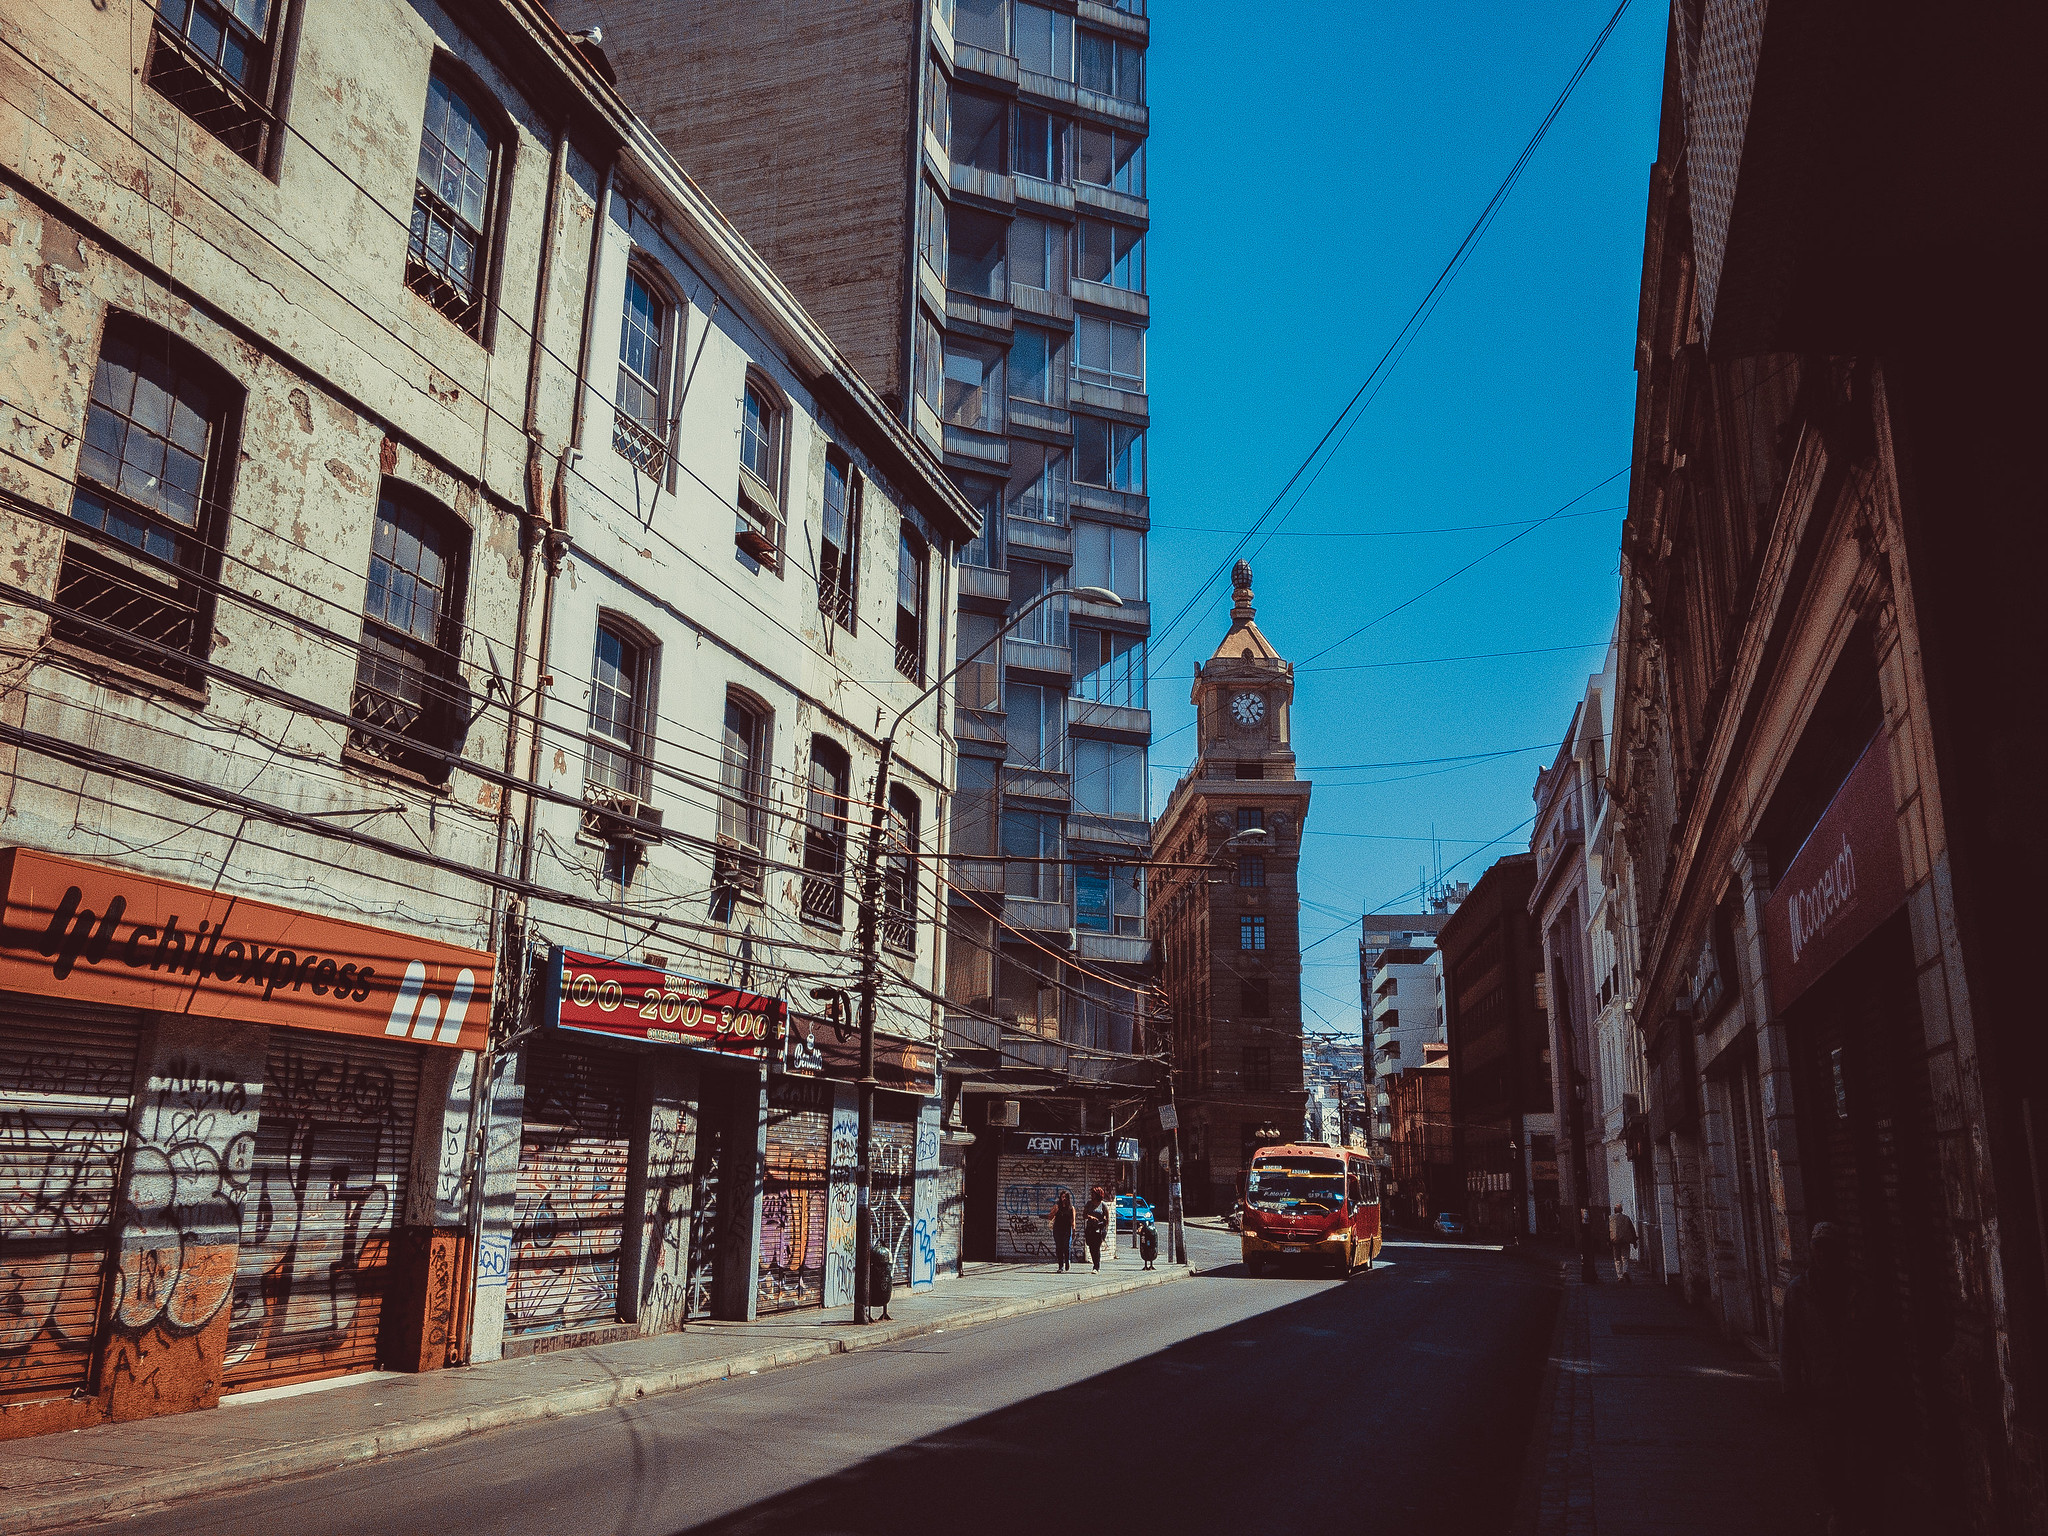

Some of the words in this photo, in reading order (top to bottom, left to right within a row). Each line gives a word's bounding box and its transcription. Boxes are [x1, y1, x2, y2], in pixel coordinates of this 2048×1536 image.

[1799, 832, 1857, 943] Coopeuch
[123, 913, 375, 1003] chilexpress
[1027, 1137, 1064, 1151] AGENT
